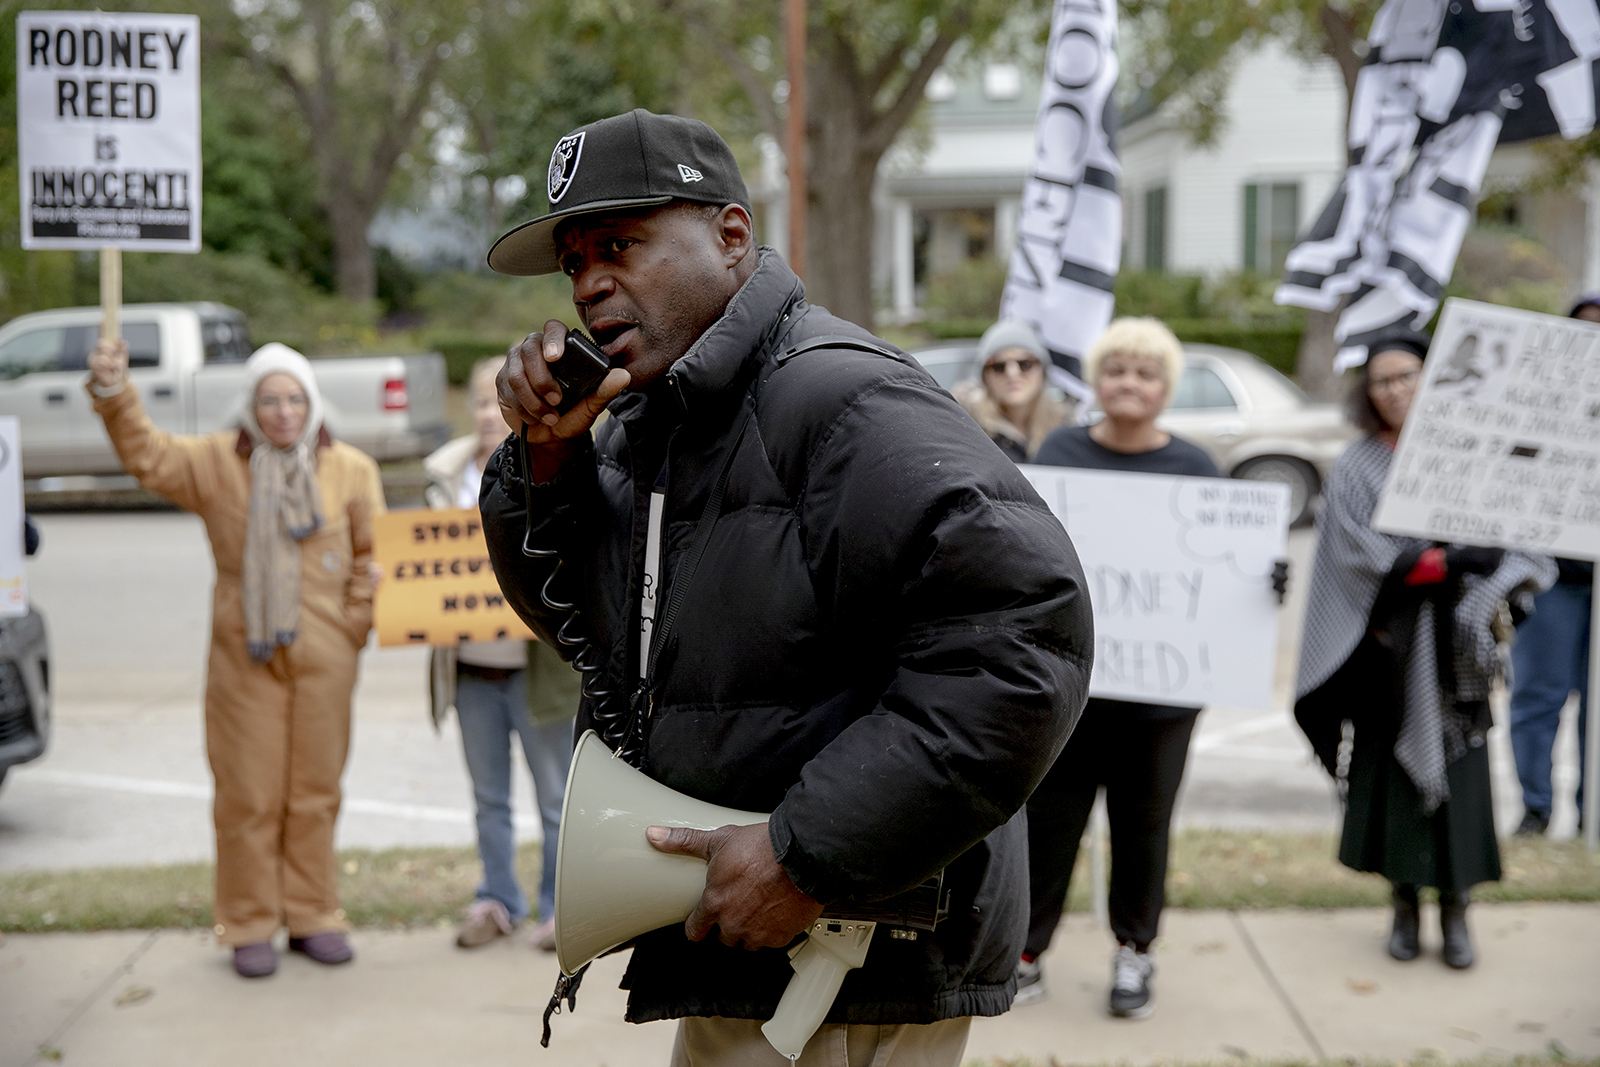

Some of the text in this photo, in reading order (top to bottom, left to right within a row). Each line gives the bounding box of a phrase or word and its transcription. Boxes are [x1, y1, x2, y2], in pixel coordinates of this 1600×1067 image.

[29, 28, 186, 70] RODNEY
[57, 79, 157, 119] REED
[94, 135, 118, 161] IS
[31, 169, 189, 204] INNOCENT!
[394, 557, 494, 581] EXECU
